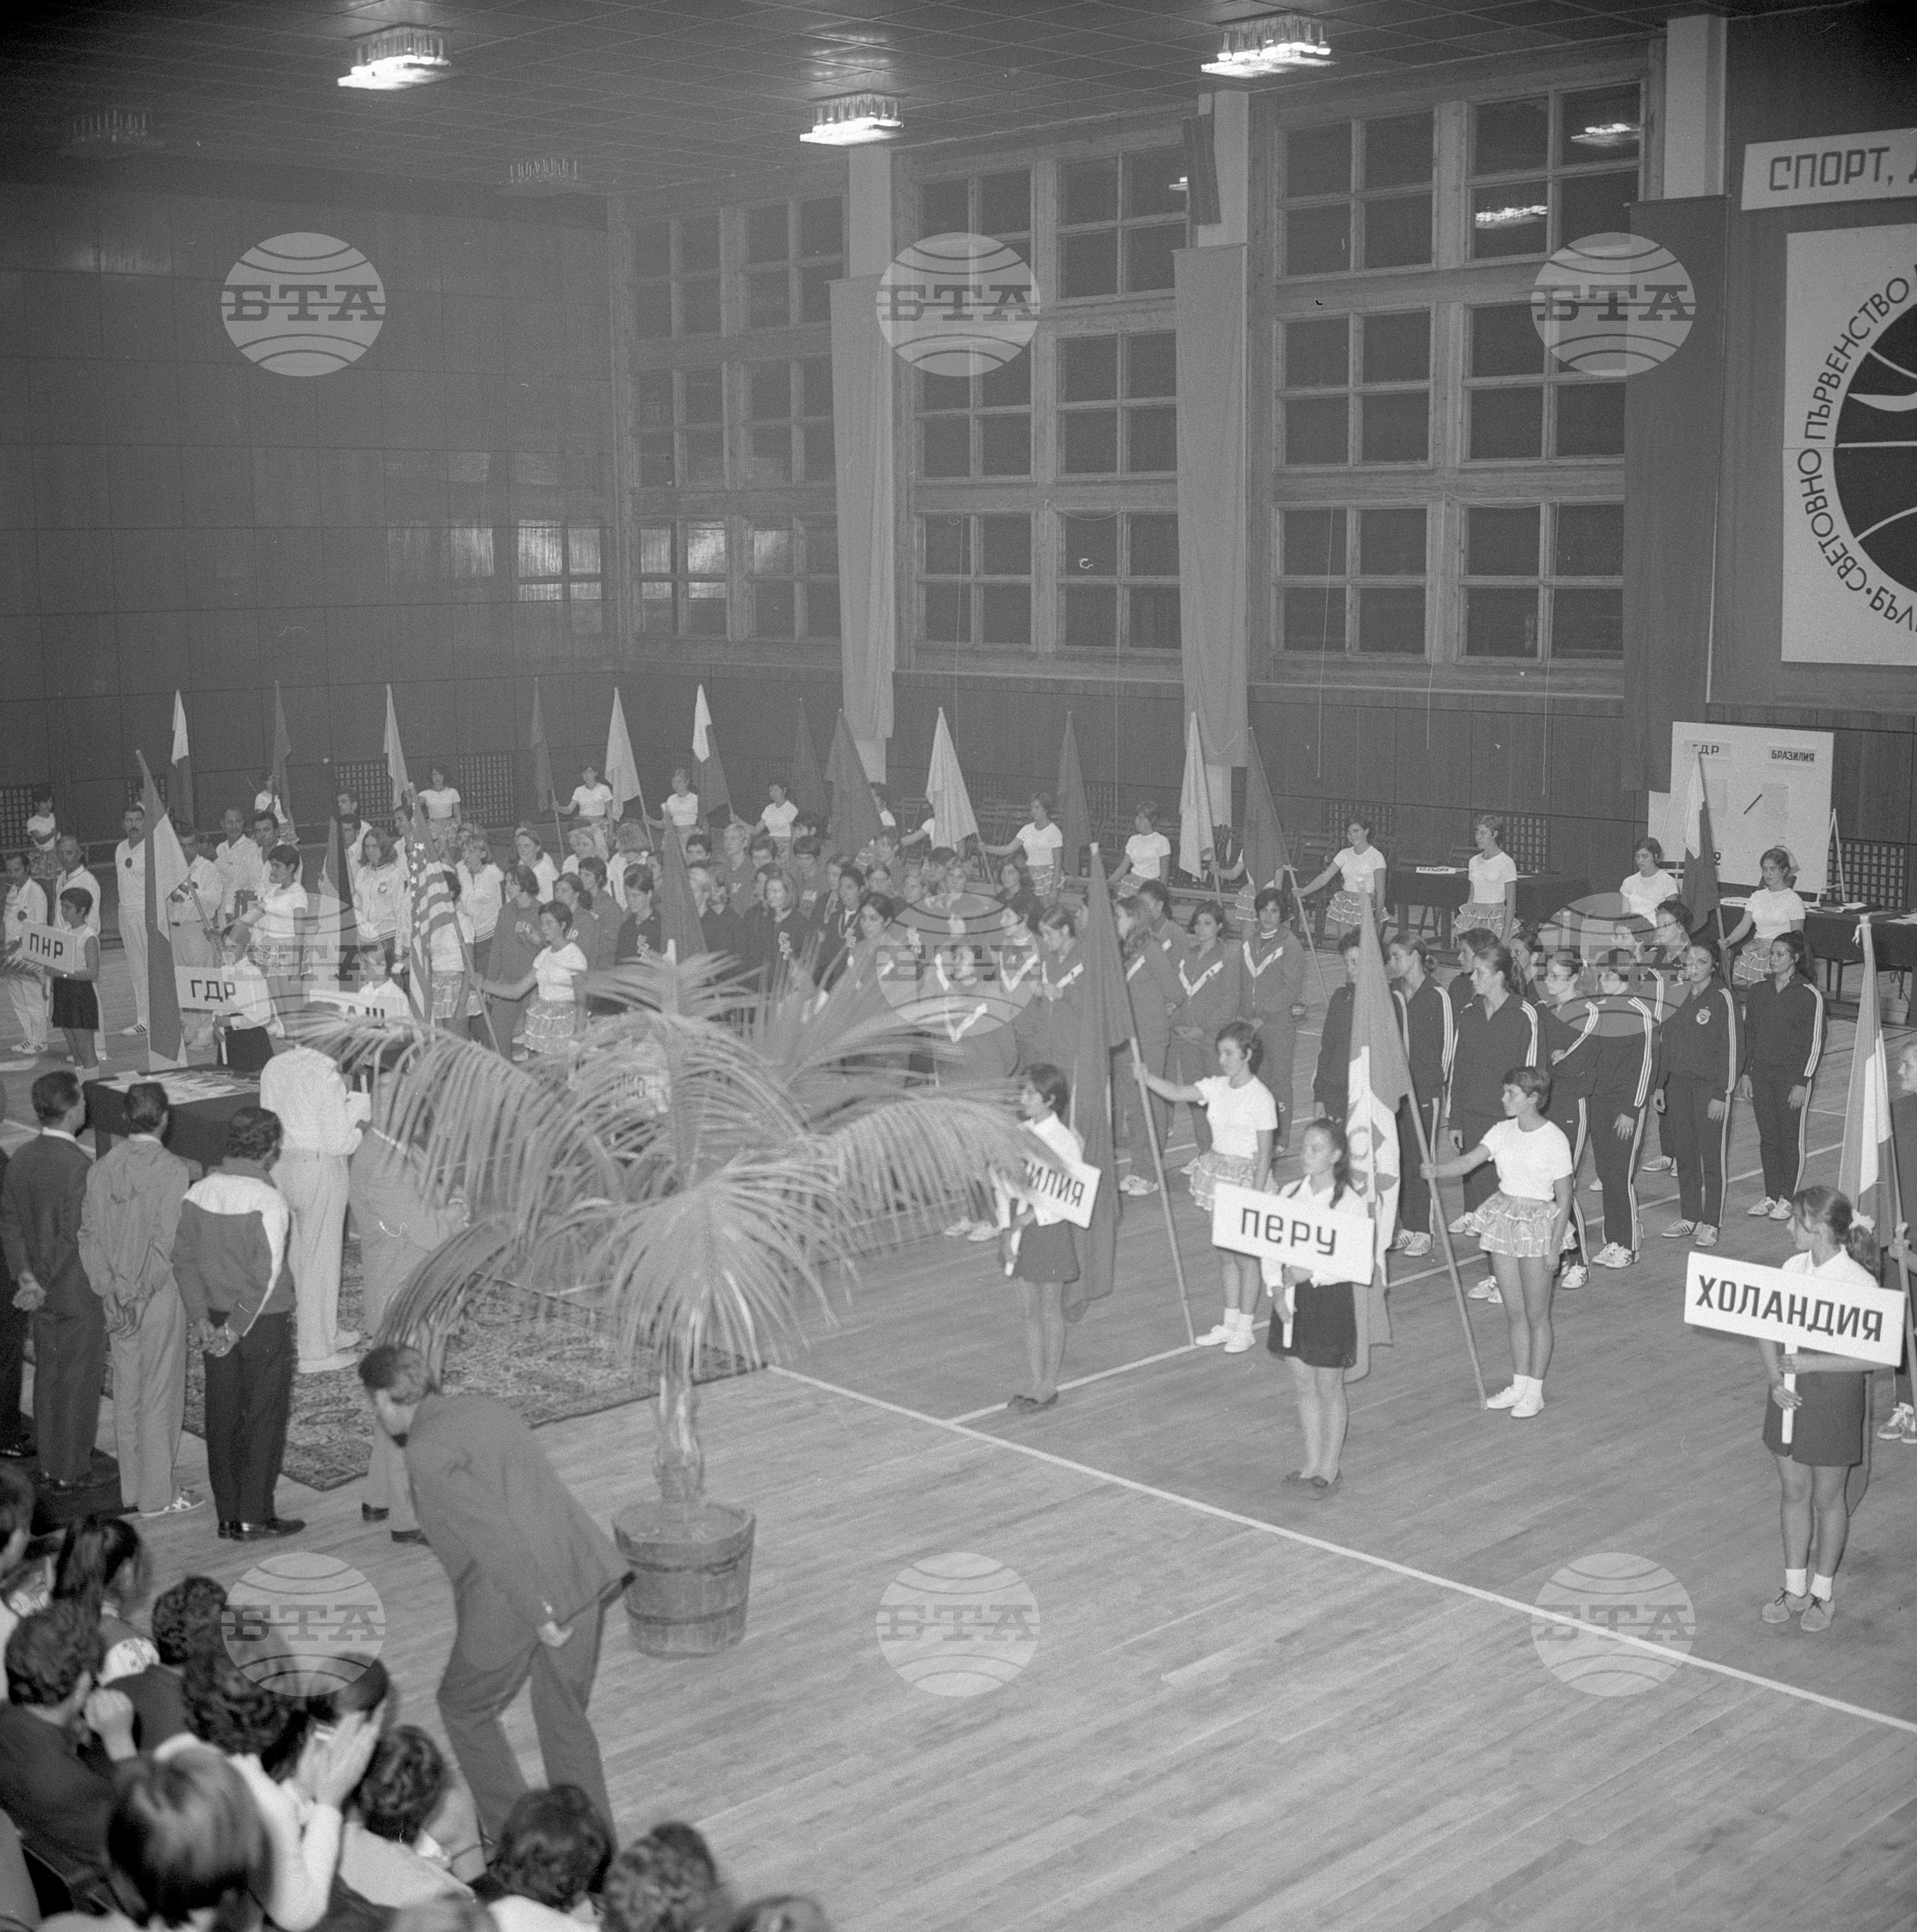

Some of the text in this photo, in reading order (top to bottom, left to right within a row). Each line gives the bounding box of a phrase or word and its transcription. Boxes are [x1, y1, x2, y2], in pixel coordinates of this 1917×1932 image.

[1769, 146, 1894, 191] СПОРТ,
[1797, 277, 1909, 591] СВЕТОВНО ПЪРВЕНСТВО
[1869, 586, 1917, 632] БЪЛ
[1771, 750, 1815, 762] БРАЗИЛИЯ
[30, 933, 63, 960] ПНР
[190, 980, 236, 1002] ГДР
[1695, 1274, 1883, 1343] ХОЛАНДИЯ
